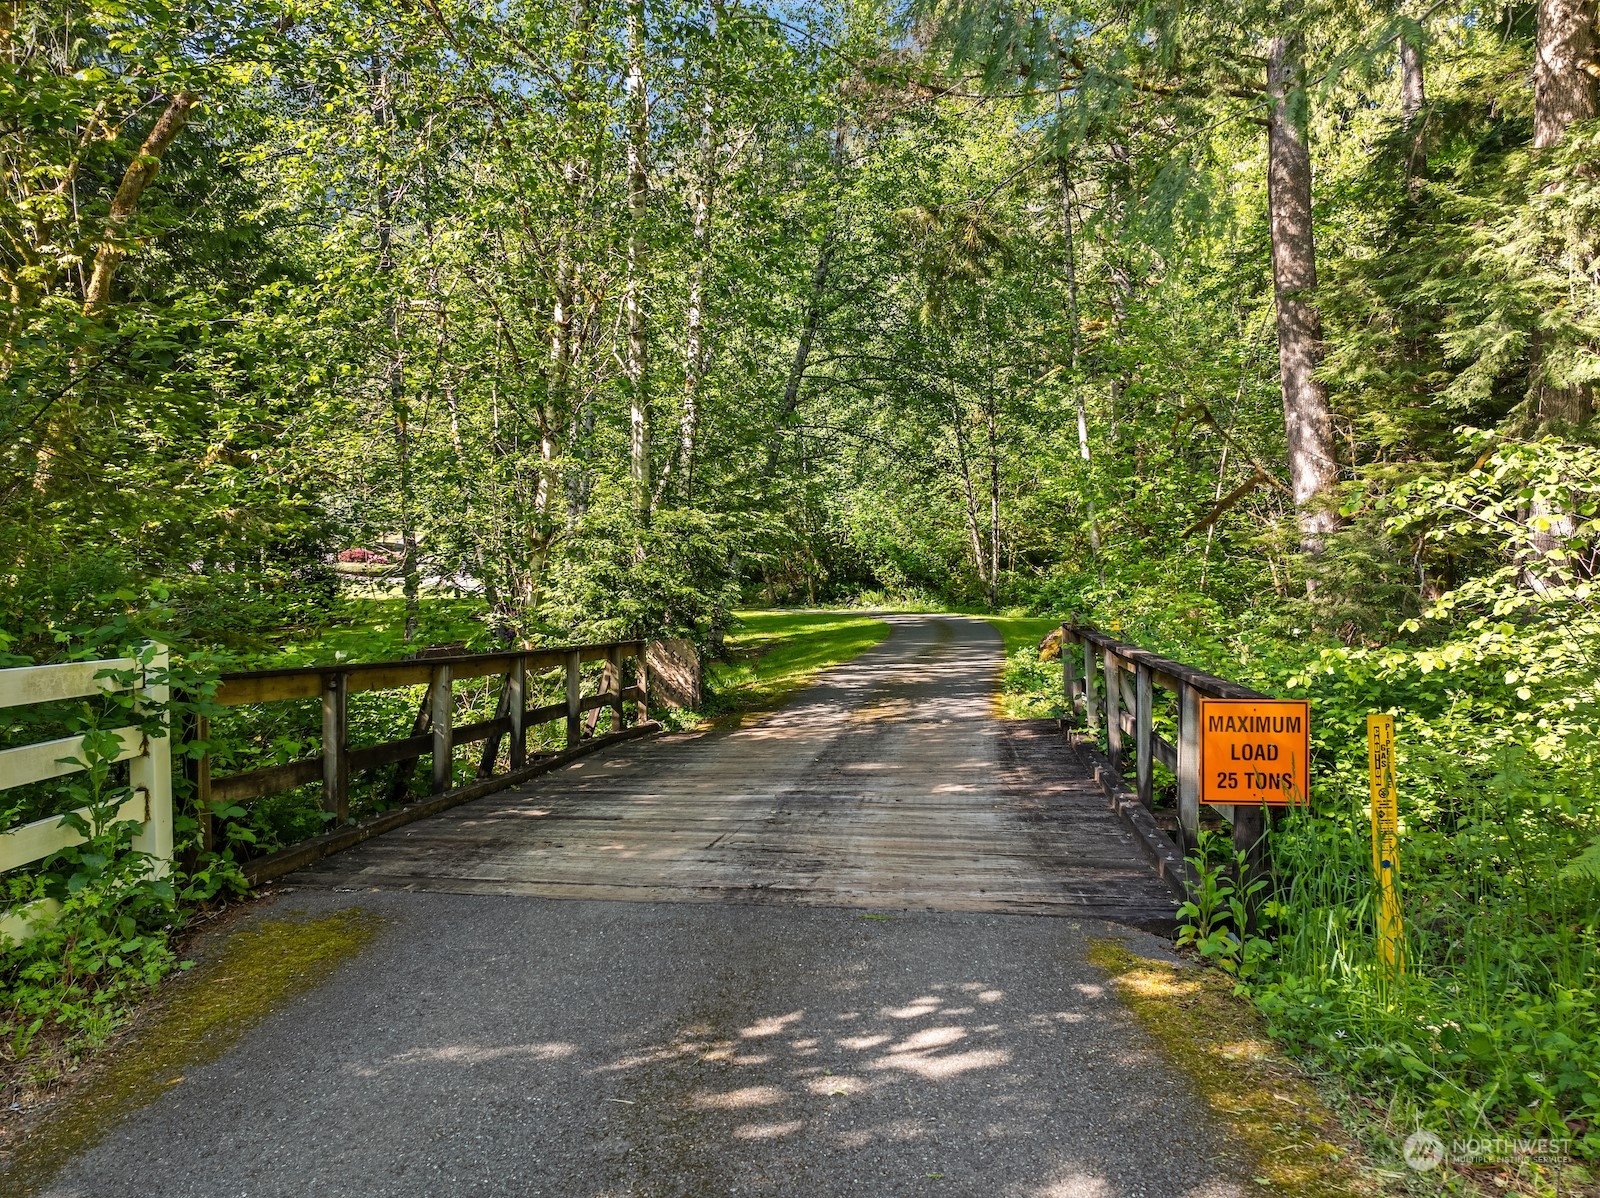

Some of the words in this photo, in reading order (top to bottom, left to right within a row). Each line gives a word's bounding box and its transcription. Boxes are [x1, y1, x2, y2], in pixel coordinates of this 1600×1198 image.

[1208, 715, 1301, 733] MAXIMUM
[1231, 743, 1279, 761] LOAD
[1217, 772, 1238, 789] 25
[1244, 772, 1293, 790] TONS
